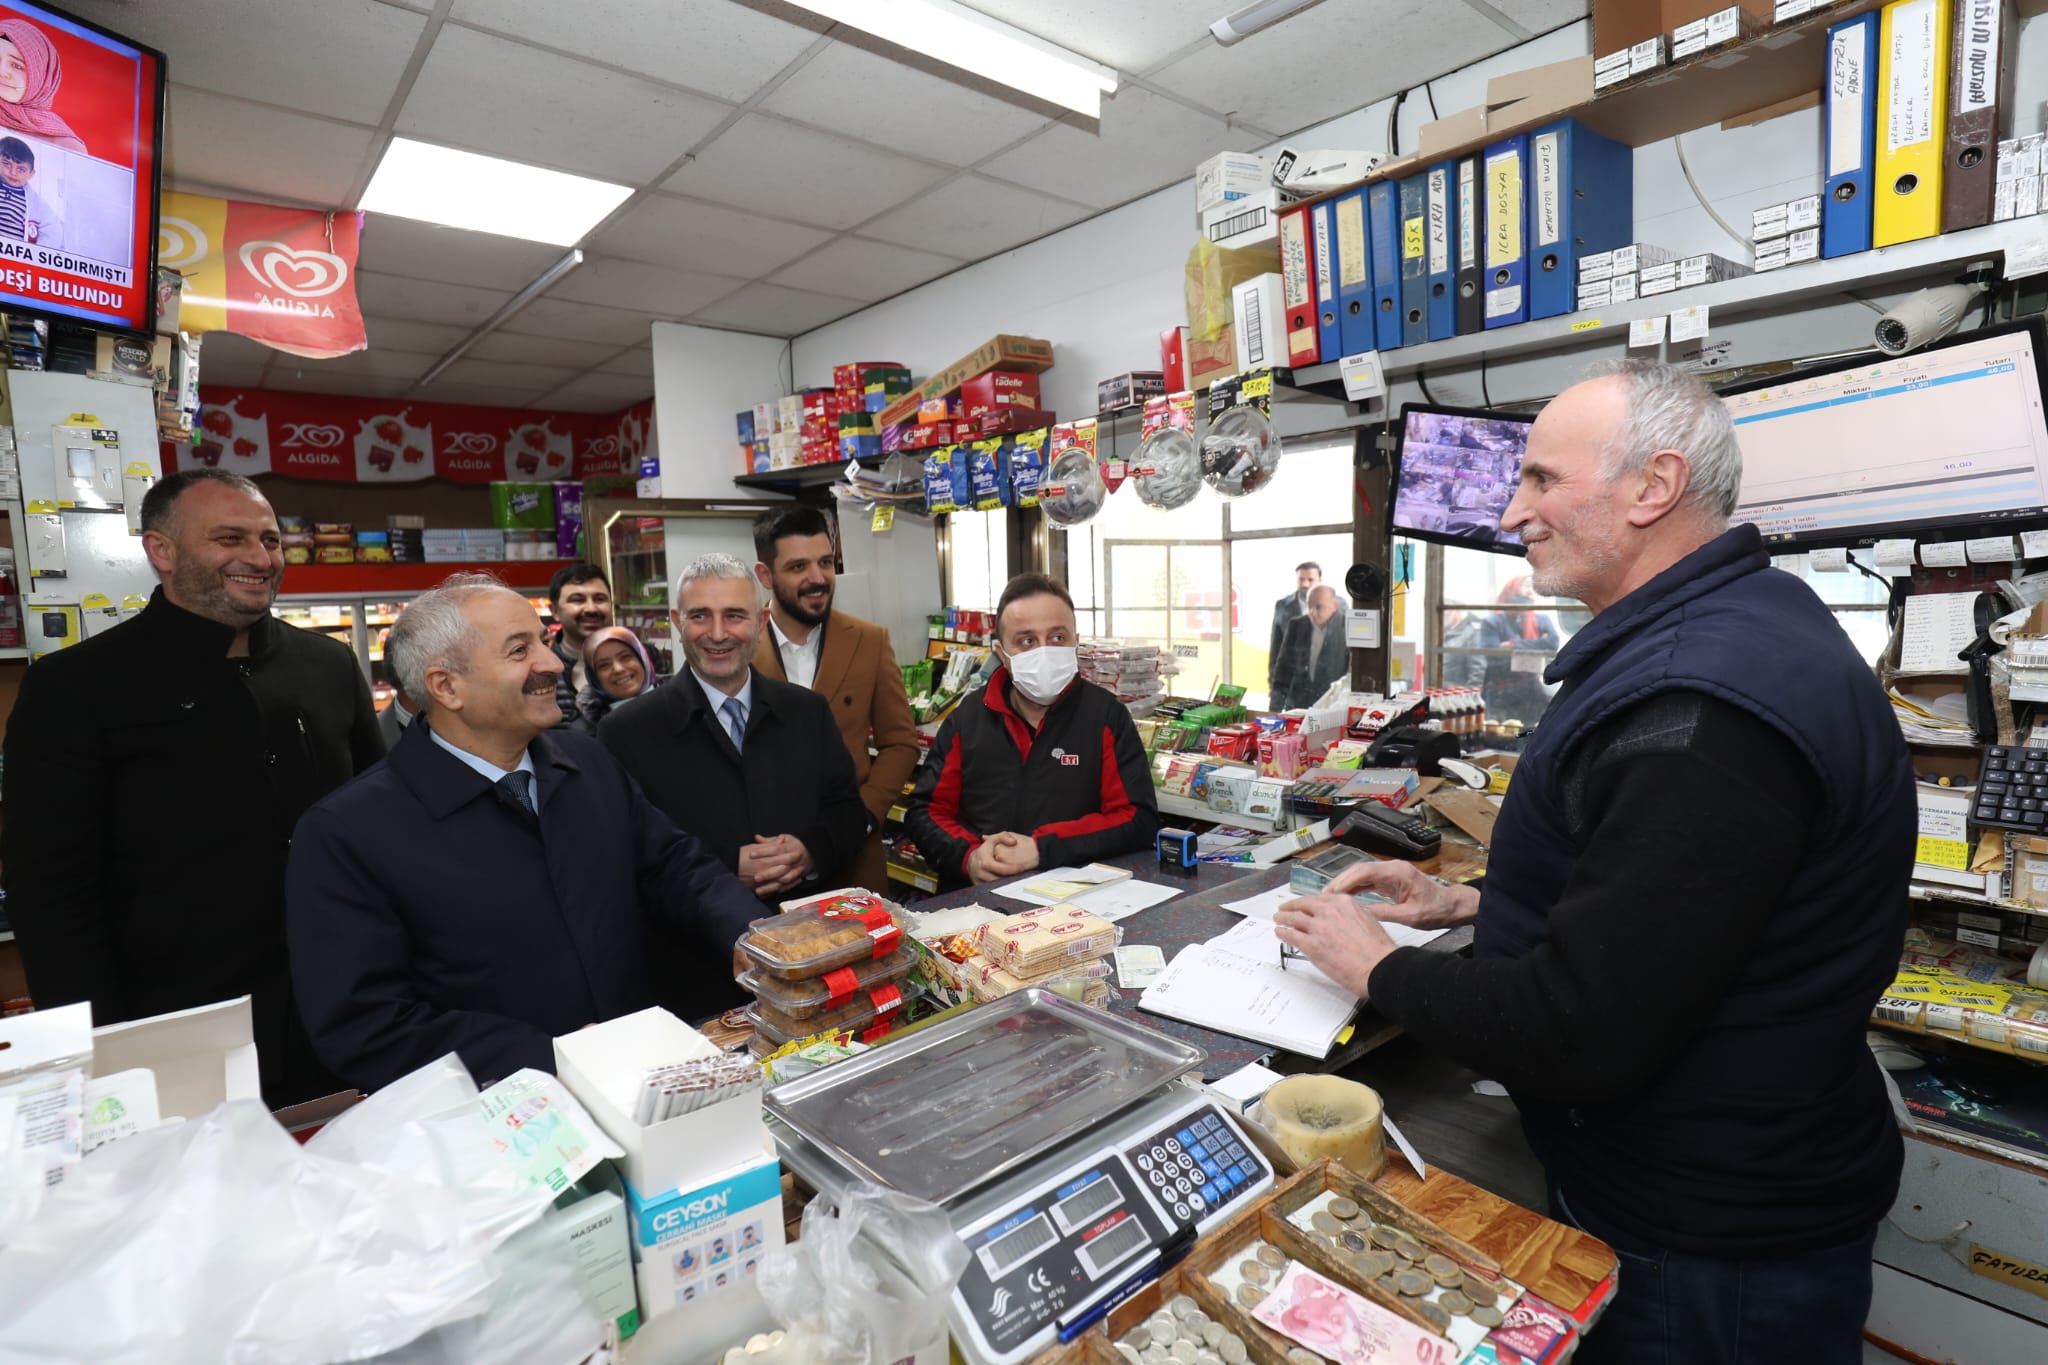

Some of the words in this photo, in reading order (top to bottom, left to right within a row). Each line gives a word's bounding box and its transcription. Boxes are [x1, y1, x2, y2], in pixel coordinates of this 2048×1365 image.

[1407, 224, 1420, 252] SSK
[38, 251, 126, 284] SIĞDIRMIŞTI
[38, 276, 123, 309] BULUNDU
[121, 352, 146, 363] GOLD
[1984, 356, 2012, 367] Tutarı
[1903, 374, 1928, 384] Fiyatı
[1142, 1155, 1151, 1168] 7
[1155, 1148, 1164, 1160] 8
[1168, 1140, 1178, 1151] 9
[1182, 1132, 1192, 1143] C
[1153, 1173, 1163, 1184] 4
[1167, 1163, 1177, 1175] 5
[1180, 1155, 1190, 1166] 6
[1165, 1188, 1174, 1200] 1
[1179, 1179, 1190, 1191] 2
[1193, 1170, 1203, 1182] 3
[652, 1193, 729, 1232] CEYSON
[1177, 1205, 1188, 1218] 0
[1973, 1251, 2048, 1284] FATURA
[1029, 1298, 1045, 1312] Max
